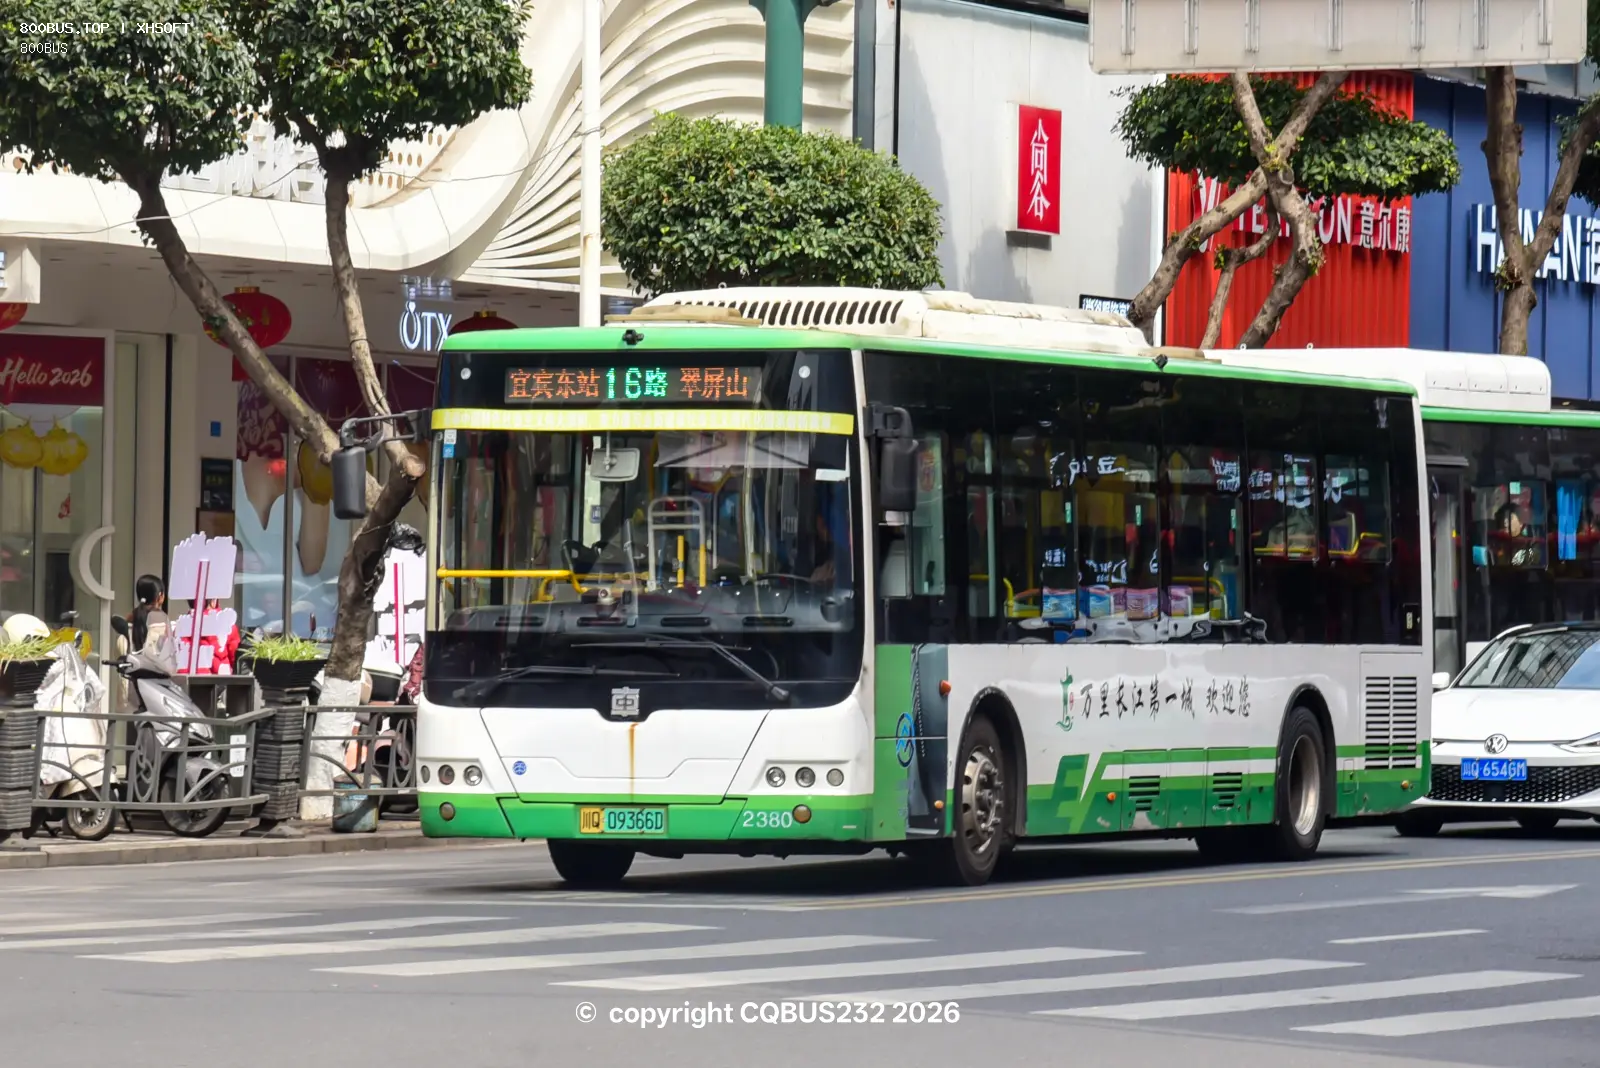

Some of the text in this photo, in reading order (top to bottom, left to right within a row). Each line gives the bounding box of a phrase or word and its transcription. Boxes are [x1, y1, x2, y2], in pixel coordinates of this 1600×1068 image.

[1359, 199, 1411, 253] 意尔康
[0, 357, 93, 392] Hello 2026
[508, 369, 600, 399] 宜宾东站
[680, 368, 748, 400] 翠屏山
[1080, 674, 1250, 720] 万里长江第一城 欢迎您
[743, 810, 793, 828] 2380
